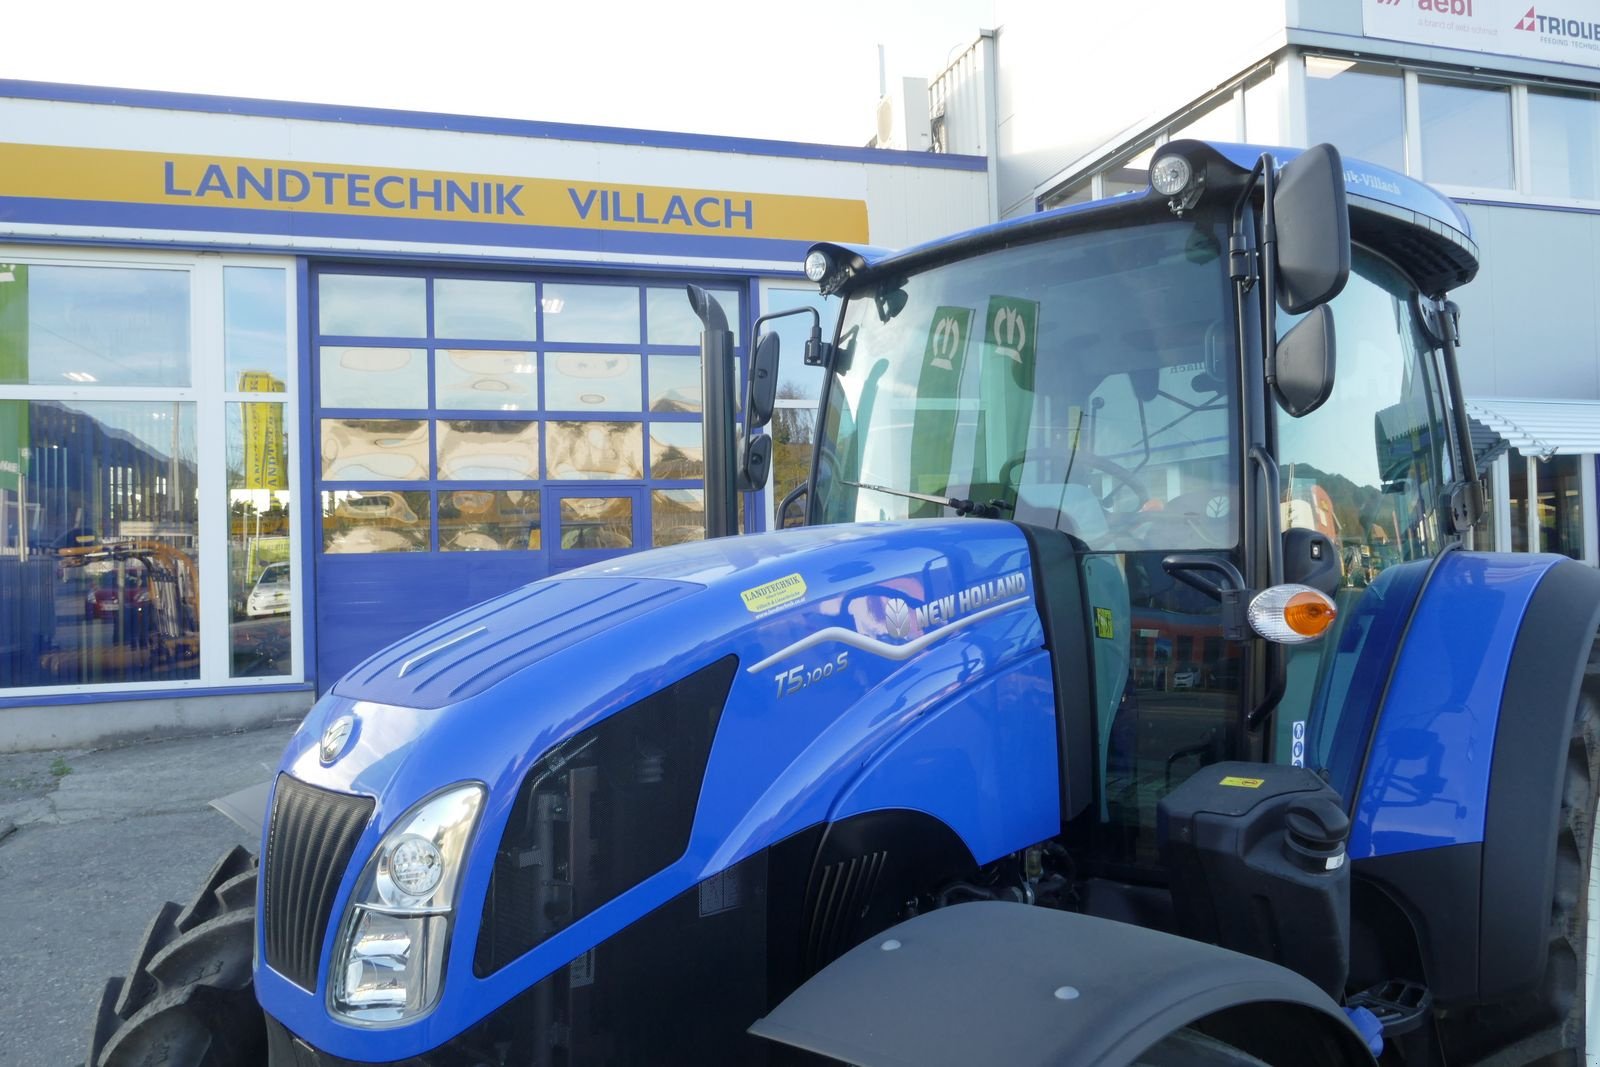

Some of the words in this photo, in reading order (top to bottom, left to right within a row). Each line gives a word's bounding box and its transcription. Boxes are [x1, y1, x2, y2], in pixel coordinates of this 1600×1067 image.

[164, 161, 525, 217] LANDTECHNIK
[568, 188, 753, 230] VILLACH
[744, 576, 801, 601] LANDTECHNIK
[915, 594, 955, 628] NEW
[958, 572, 1026, 614] HOLLAND
